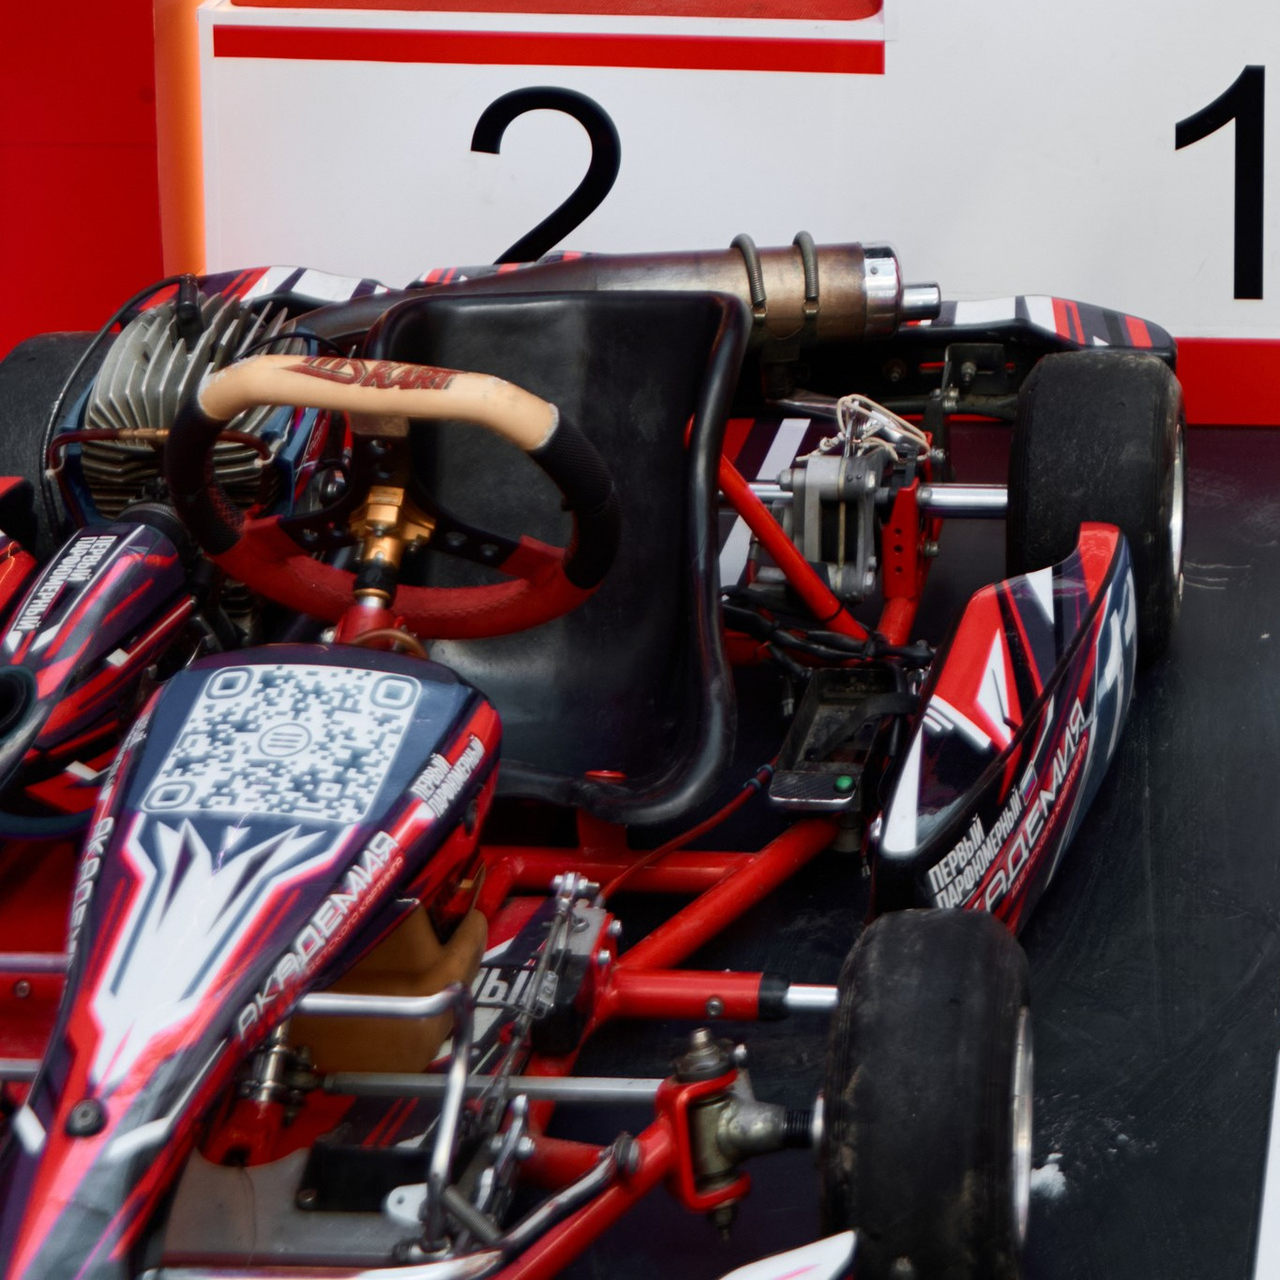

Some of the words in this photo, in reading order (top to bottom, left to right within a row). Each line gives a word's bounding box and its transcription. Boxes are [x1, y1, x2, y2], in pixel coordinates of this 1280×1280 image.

[470, 85, 622, 266] 2
[1174, 64, 1266, 300] 1
[67, 535, 118, 582] ПЕРВЫЙ
[410, 752, 452, 801] ПЕРВЫЙ
[935, 785, 1023, 909] ПАРФЮМЕРНЫЙ
[974, 696, 1086, 913] АДЕМИЯ
[928, 813, 985, 893] ПЕРВЫЙ
[238, 830, 399, 1041] АКАДЕМИЯ
